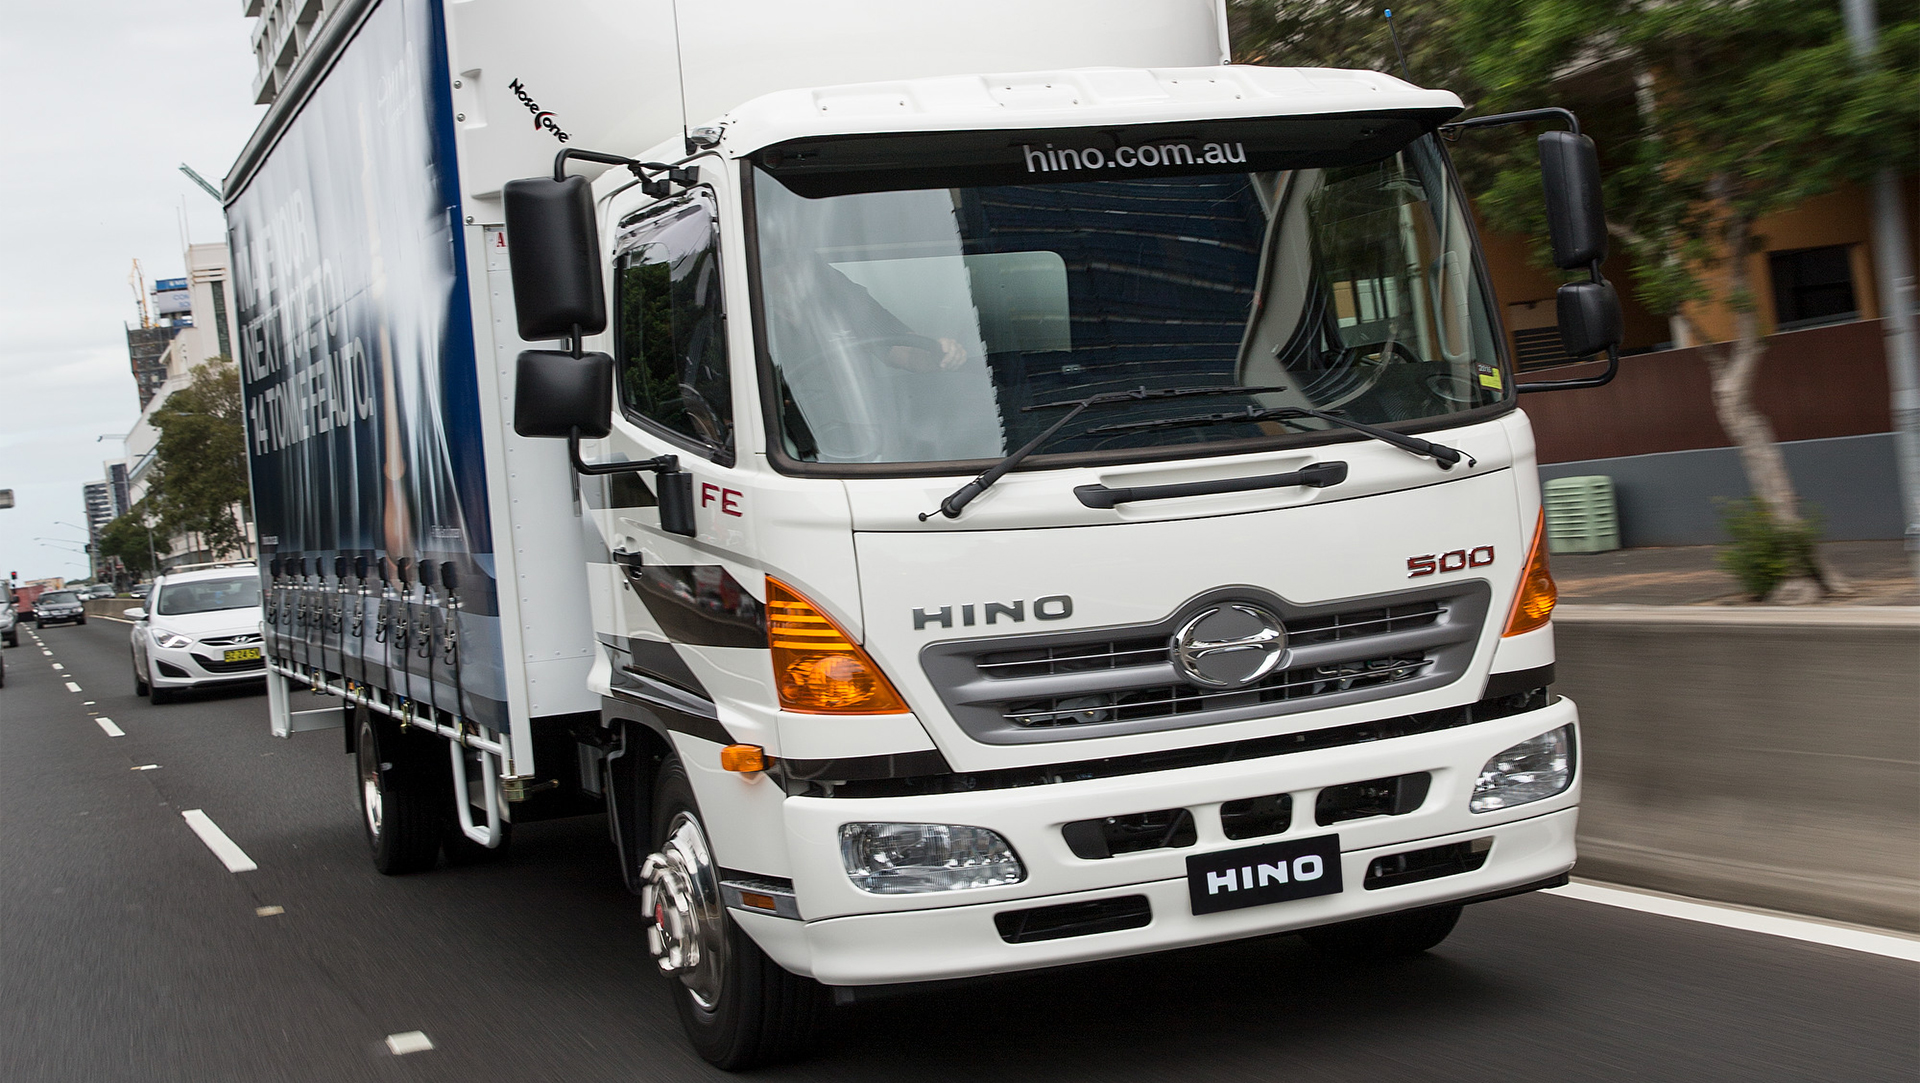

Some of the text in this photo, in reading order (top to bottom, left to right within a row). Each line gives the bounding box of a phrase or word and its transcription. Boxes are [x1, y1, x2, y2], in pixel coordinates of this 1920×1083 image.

[1022, 142, 1247, 173] hino.com.au
[242, 308, 281, 384] NEXT
[250, 394, 269, 457] 14
[308, 359, 329, 437] FE
[702, 482, 744, 517] FE
[1406, 544, 1495, 578] 500
[912, 594, 1073, 631] HINO
[1206, 854, 1324, 895] HINO
